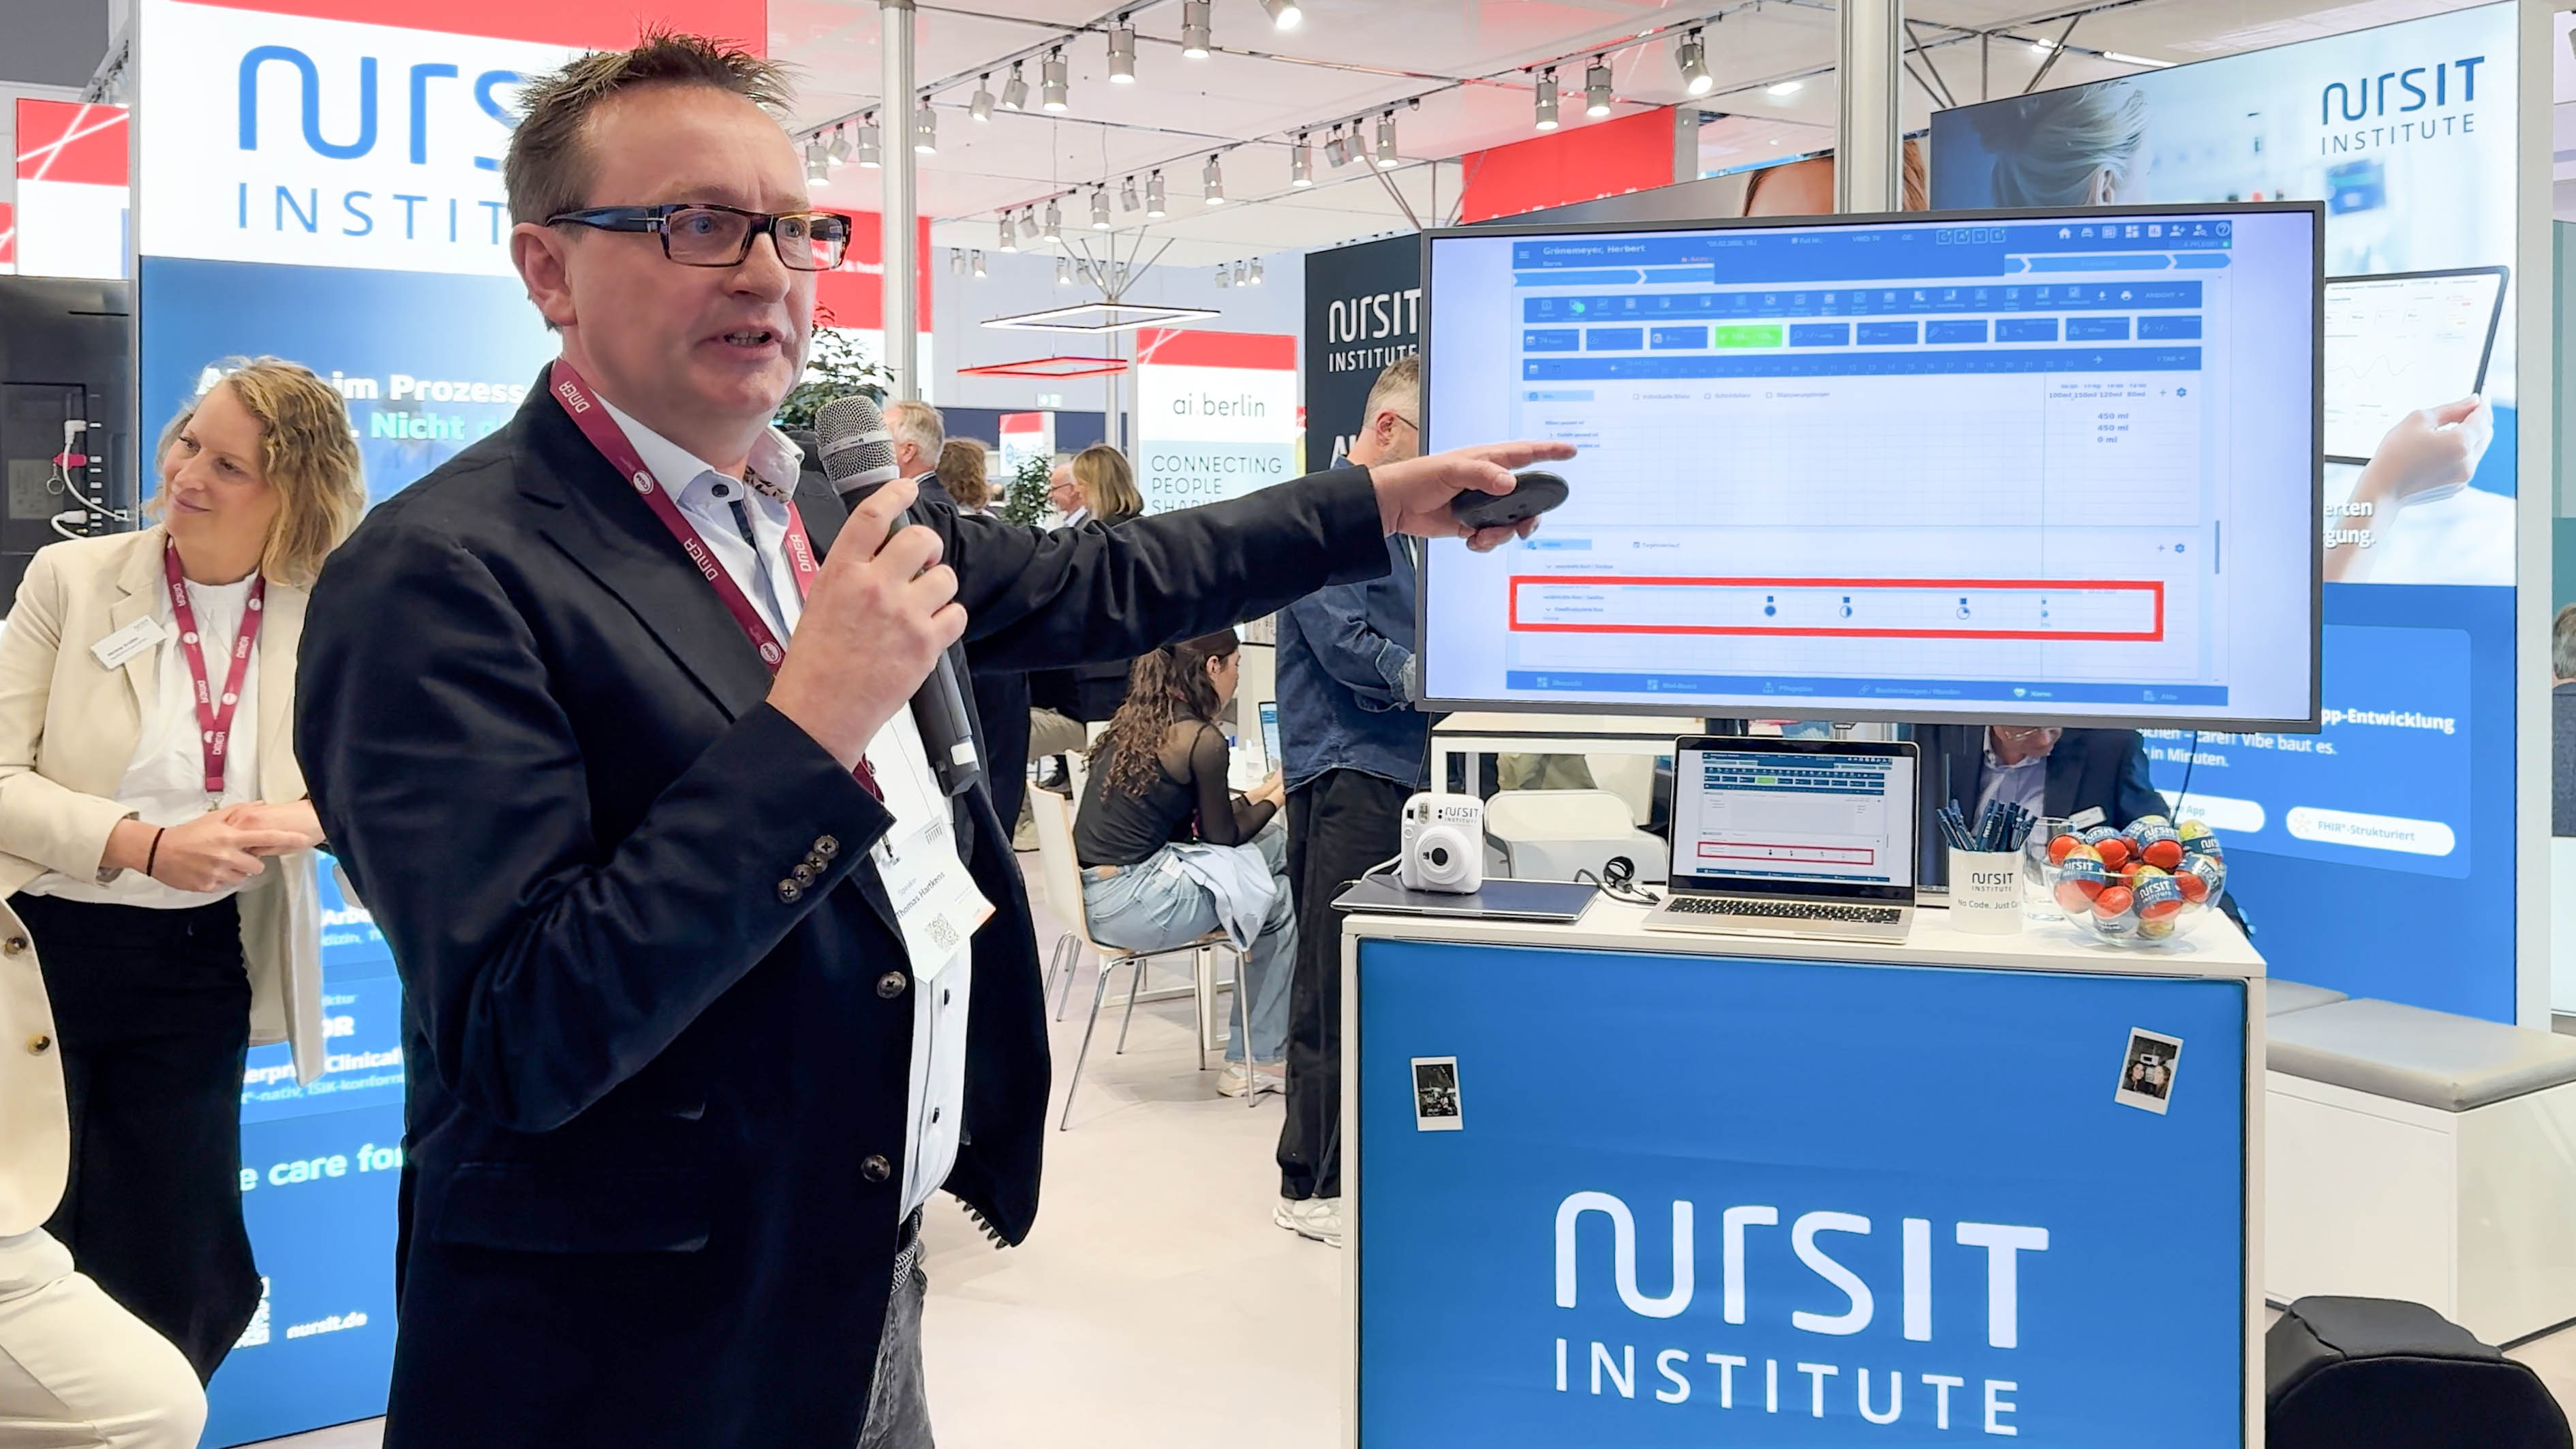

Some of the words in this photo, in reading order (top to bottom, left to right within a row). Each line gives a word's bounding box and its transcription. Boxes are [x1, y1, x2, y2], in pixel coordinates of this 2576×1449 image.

[2322, 113, 2475, 155] INSTITUTE
[332, 371, 378, 399] im
[371, 412, 465, 440] Nicht
[1151, 455, 1282, 474] CONNECTING
[1152, 478, 1222, 494] PEOPLE
[2278, 737, 2312, 752] baut
[895, 896, 921, 920] Thomas
[1958, 899, 1967, 907] No
[1968, 900, 1991, 909] Code.
[1995, 901, 2009, 909] Just
[268, 1154, 348, 1187] care
[1556, 1337, 2018, 1436] INSTITUTE
